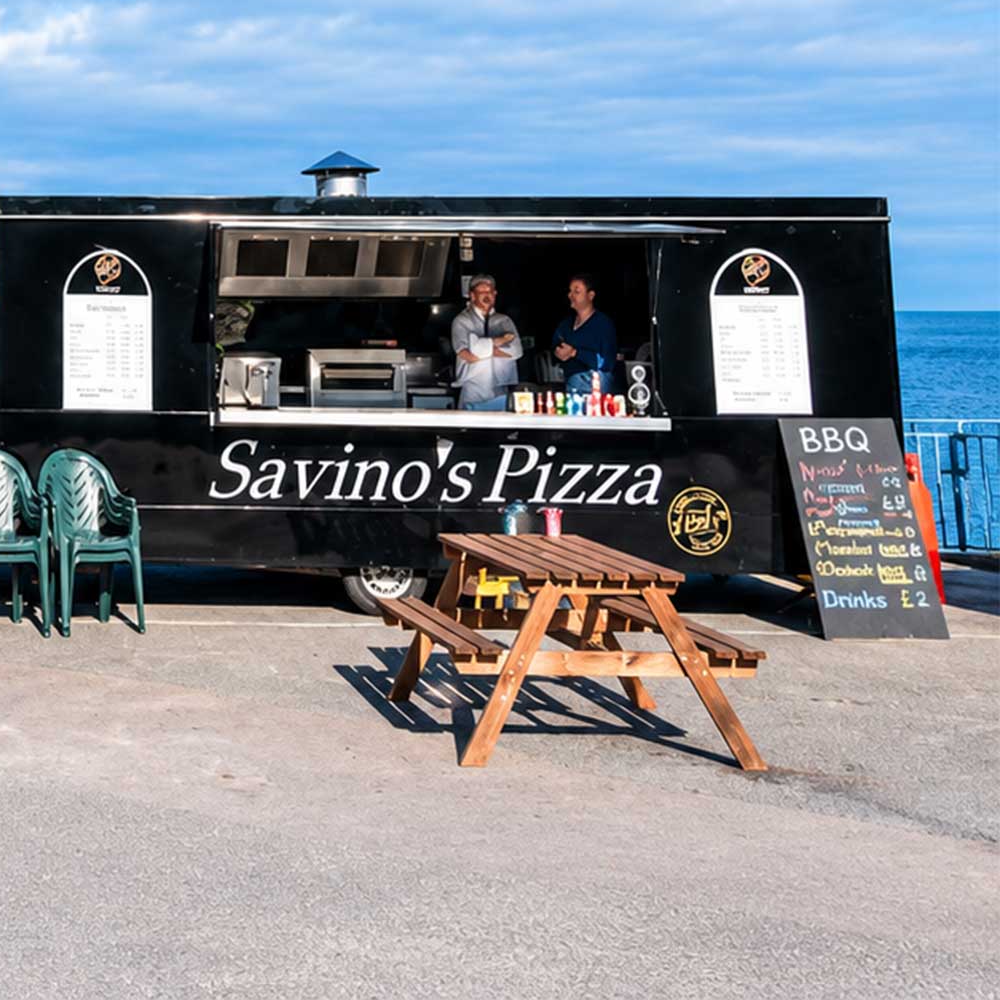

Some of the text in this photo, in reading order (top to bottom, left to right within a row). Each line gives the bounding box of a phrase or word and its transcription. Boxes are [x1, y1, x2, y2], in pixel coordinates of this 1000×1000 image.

[799, 426, 871, 453] BBQ
[208, 438, 662, 506] Savino's Pizza
[822, 589, 888, 609] Drinks
